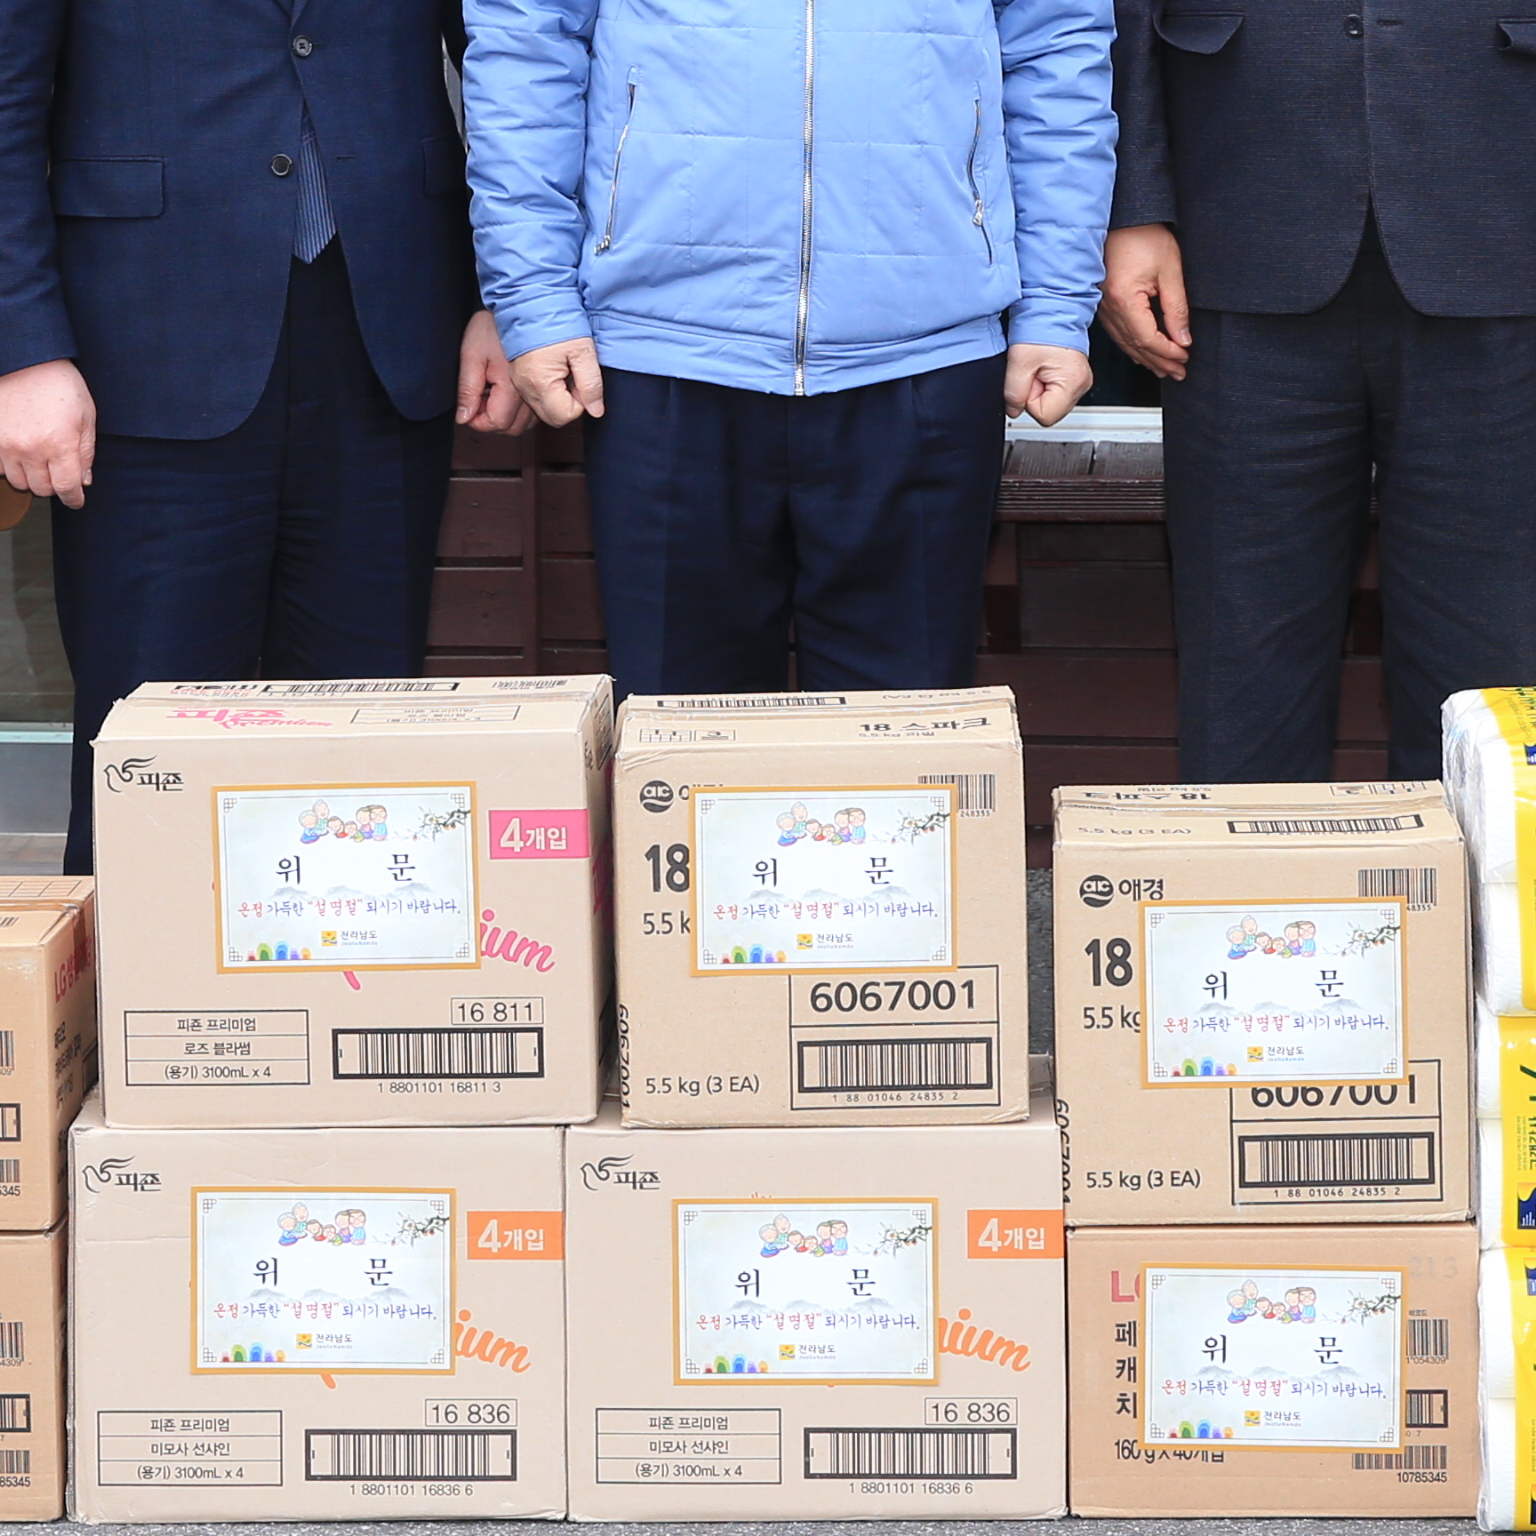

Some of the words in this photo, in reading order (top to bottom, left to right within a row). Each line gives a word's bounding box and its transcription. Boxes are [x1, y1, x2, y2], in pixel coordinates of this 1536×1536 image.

[137, 772, 184, 791] 피죤
[499, 817, 567, 852] 4개입
[276, 855, 301, 885] 위
[386, 853, 416, 882] 문
[753, 858, 778, 887] 위
[864, 856, 893, 885] 문
[1118, 878, 1164, 901] 애경
[643, 912, 674, 934] 5.5
[1084, 938, 1133, 987] 18
[1203, 971, 1228, 1001] 위
[1314, 969, 1344, 998] 문
[810, 980, 975, 1012] 6067001
[457, 1003, 485, 1022] 16
[492, 1003, 533, 1022] 811
[1083, 1007, 1115, 1029] 5.5
[177, 1017, 202, 1032] 피죤
[207, 1017, 256, 1032] 프리미엄
[184, 1042, 209, 1056] 로즈
[213, 1041, 251, 1056] 블라썸
[1267, 1045, 1304, 1055] 전라남도
[165, 1064, 198, 1081] (용기)
[202, 1066, 248, 1078] 3100mL
[263, 1066, 271, 1078] 4
[388, 1081, 443, 1093] 8801101
[646, 1077, 674, 1094] 5.5
[678, 1076, 701, 1097] kg
[706, 1075, 724, 1095] (3
[729, 1074, 759, 1094] EA)
[115, 1172, 162, 1192] 피죤
[613, 1171, 661, 1191] 피죤
[1086, 1172, 1114, 1188] 5.5
[1119, 1171, 1141, 1191] kg
[1147, 1170, 1164, 1190] (3
[1170, 1169, 1200, 1189] EA)
[477, 1219, 545, 1252] 4개입
[977, 1218, 1045, 1252] 4개입
[253, 1257, 278, 1286] 위
[364, 1258, 393, 1286] 문
[735, 1269, 760, 1298] 위
[846, 1269, 875, 1297] 문
[316, 1334, 352, 1343] 전라남도
[1202, 1334, 1227, 1363] 위
[1313, 1336, 1343, 1365] 문
[431, 1405, 458, 1424] 16
[467, 1404, 510, 1424] 836
[931, 1403, 958, 1422] 16
[967, 1403, 1010, 1422] 836
[150, 1418, 176, 1432] 피죤
[180, 1418, 230, 1432] 프리미엄
[648, 1416, 675, 1430] 피죤
[678, 1416, 728, 1430] 프리미엄
[151, 1442, 189, 1456] 미모사
[192, 1441, 230, 1456] 선샤인
[649, 1440, 687, 1454] 미모사
[690, 1440, 729, 1454] 선샤인
[137, 1464, 171, 1481] (용기)
[174, 1466, 222, 1480] 3100mL
[1397, 1472, 1447, 1483] 10785345
